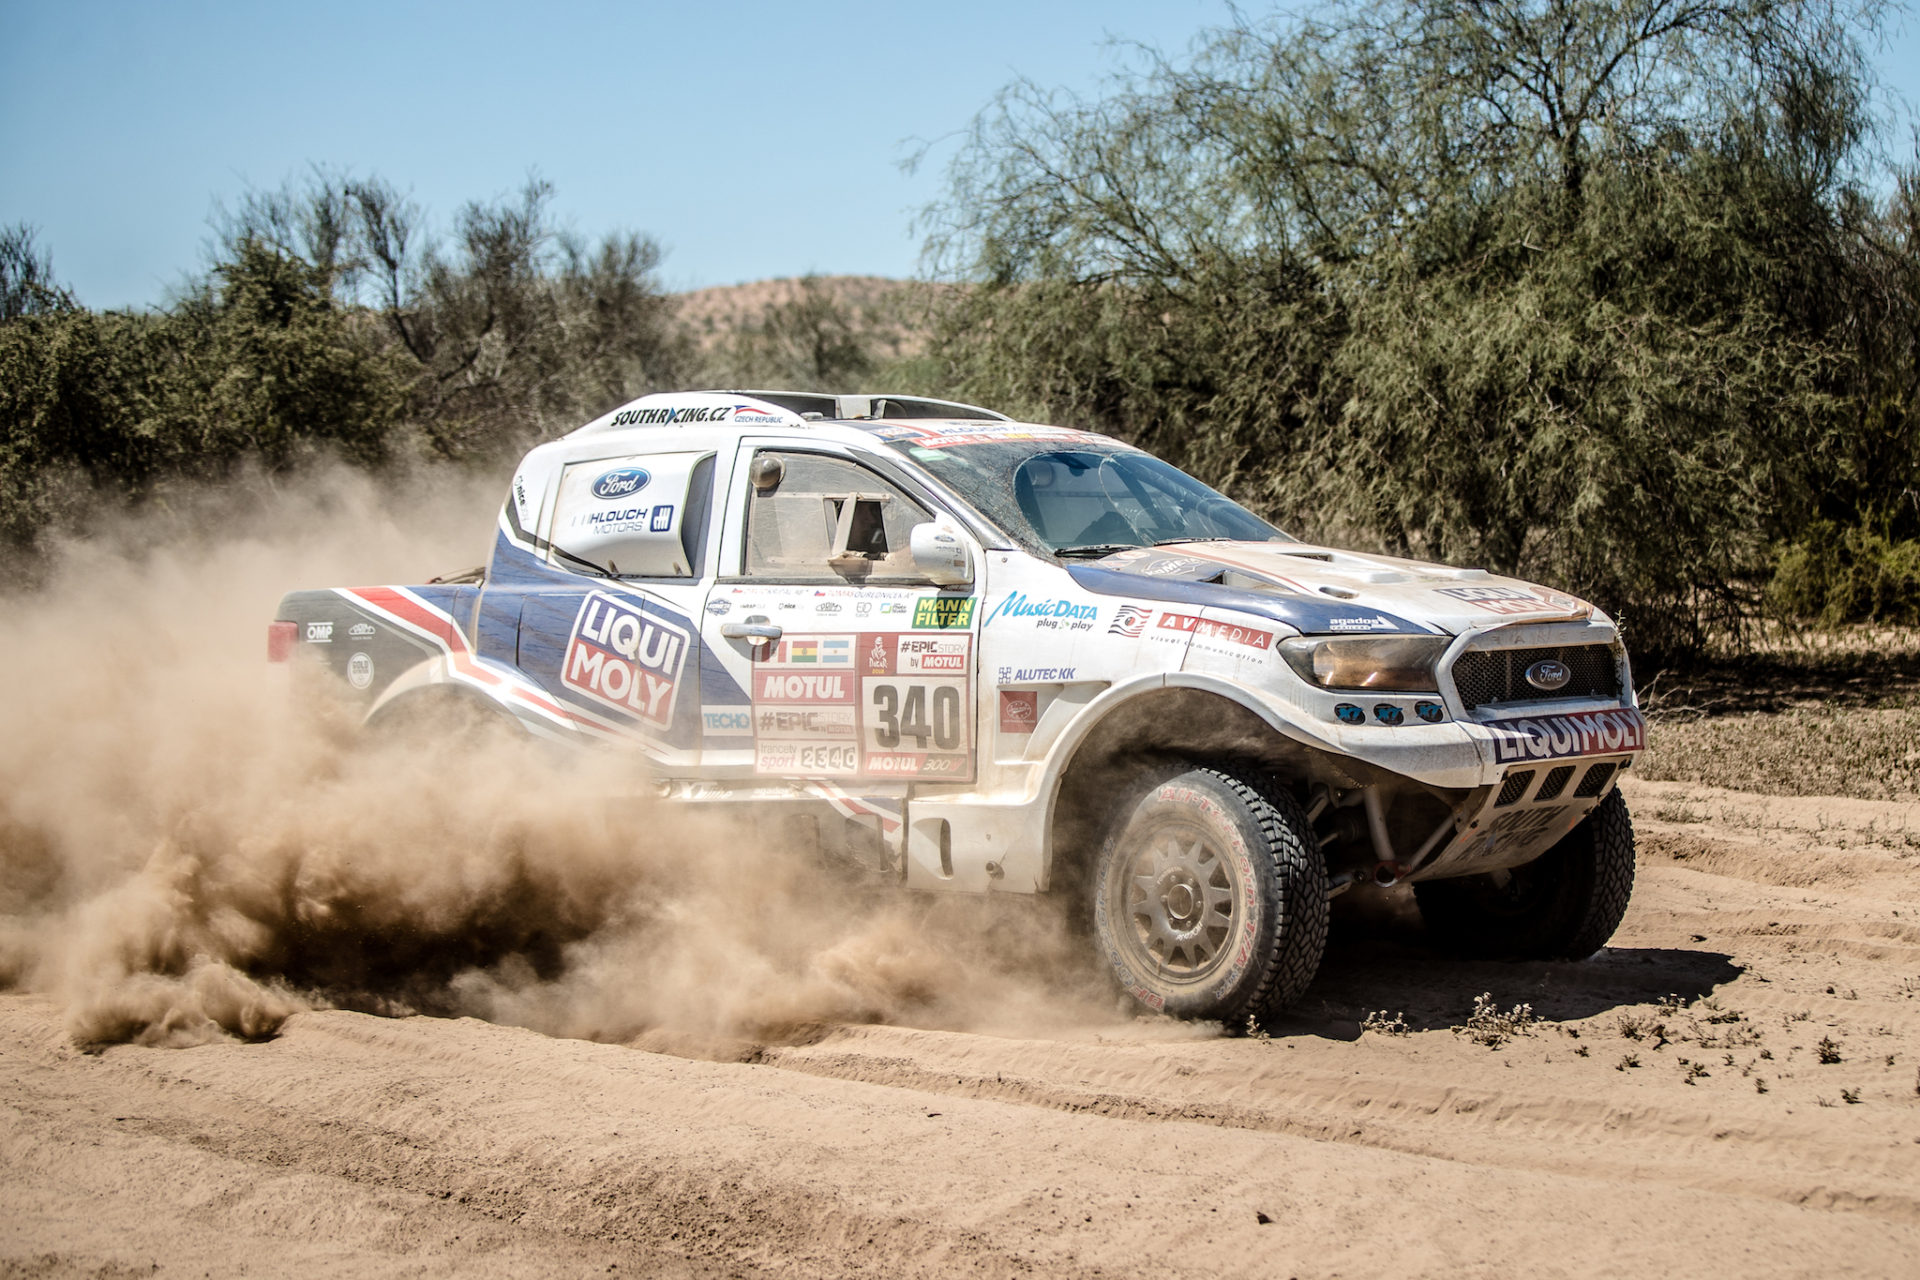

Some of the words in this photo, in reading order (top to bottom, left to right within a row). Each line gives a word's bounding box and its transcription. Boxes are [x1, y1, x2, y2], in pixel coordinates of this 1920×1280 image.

[734, 415, 754, 424] CZECH
[755, 416, 783, 424] REPUBLIC
[600, 471, 640, 497] Ford
[590, 508, 648, 524] HLOUCH
[594, 520, 644, 535] MOTORS
[918, 599, 972, 612] MANN
[915, 612, 969, 627] FILTER
[1037, 618, 1058, 630] plug
[1070, 620, 1094, 632] play
[1330, 617, 1379, 626] agados
[307, 625, 333, 640] OMP
[581, 599, 681, 675] LIQUI
[1150, 636, 1181, 645] visual
[1184, 640, 1264, 665] communication
[911, 657, 919, 668] by
[924, 656, 962, 668] MOTUL
[569, 642, 673, 718] MOLY
[1015, 668, 1058, 680] ALUTEC
[1058, 667, 1077, 680] KK
[1540, 664, 1563, 682] Ford
[763, 675, 846, 699] MOTUL
[872, 684, 961, 750] 340
[1488, 716, 1581, 760] LIQUI
[1568, 710, 1644, 751] MOLY
[760, 754, 796, 770] sport
[868, 756, 918, 771] MOTUL
[923, 758, 966, 772] 300V
